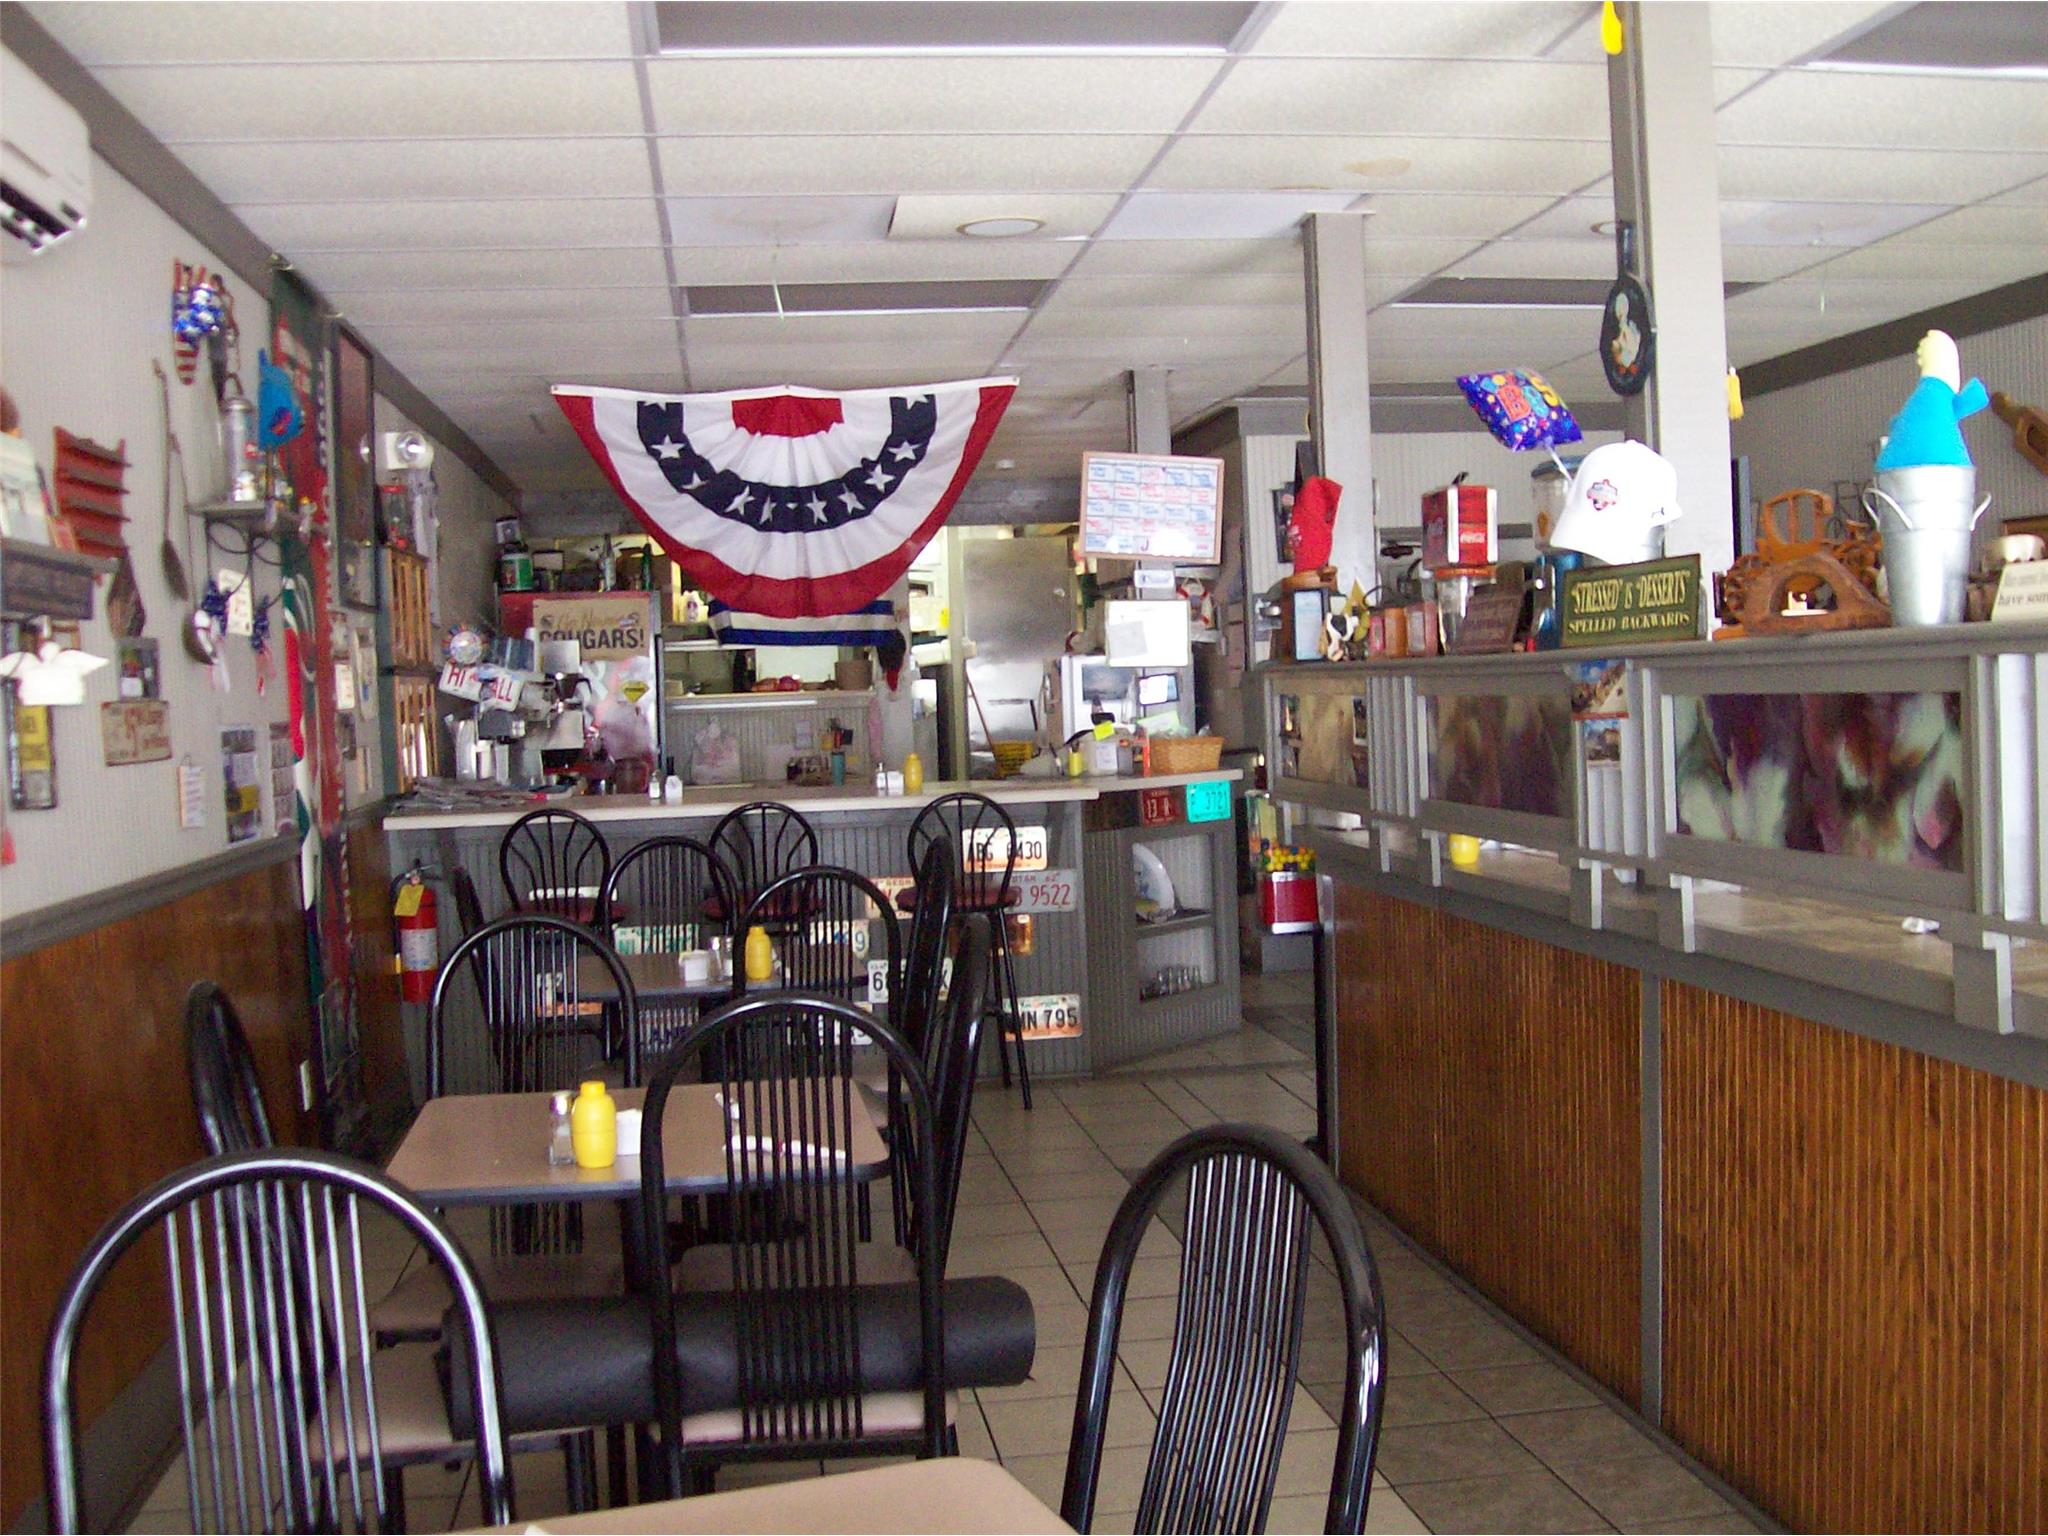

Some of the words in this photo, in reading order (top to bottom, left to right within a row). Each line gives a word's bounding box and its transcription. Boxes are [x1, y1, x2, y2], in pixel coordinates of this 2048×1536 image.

[1568, 616, 1616, 633] SPELLED
[1621, 611, 1690, 631] BACKWARDS
[1030, 884, 1072, 906] 9522
[1044, 1007, 1078, 1029] 795
